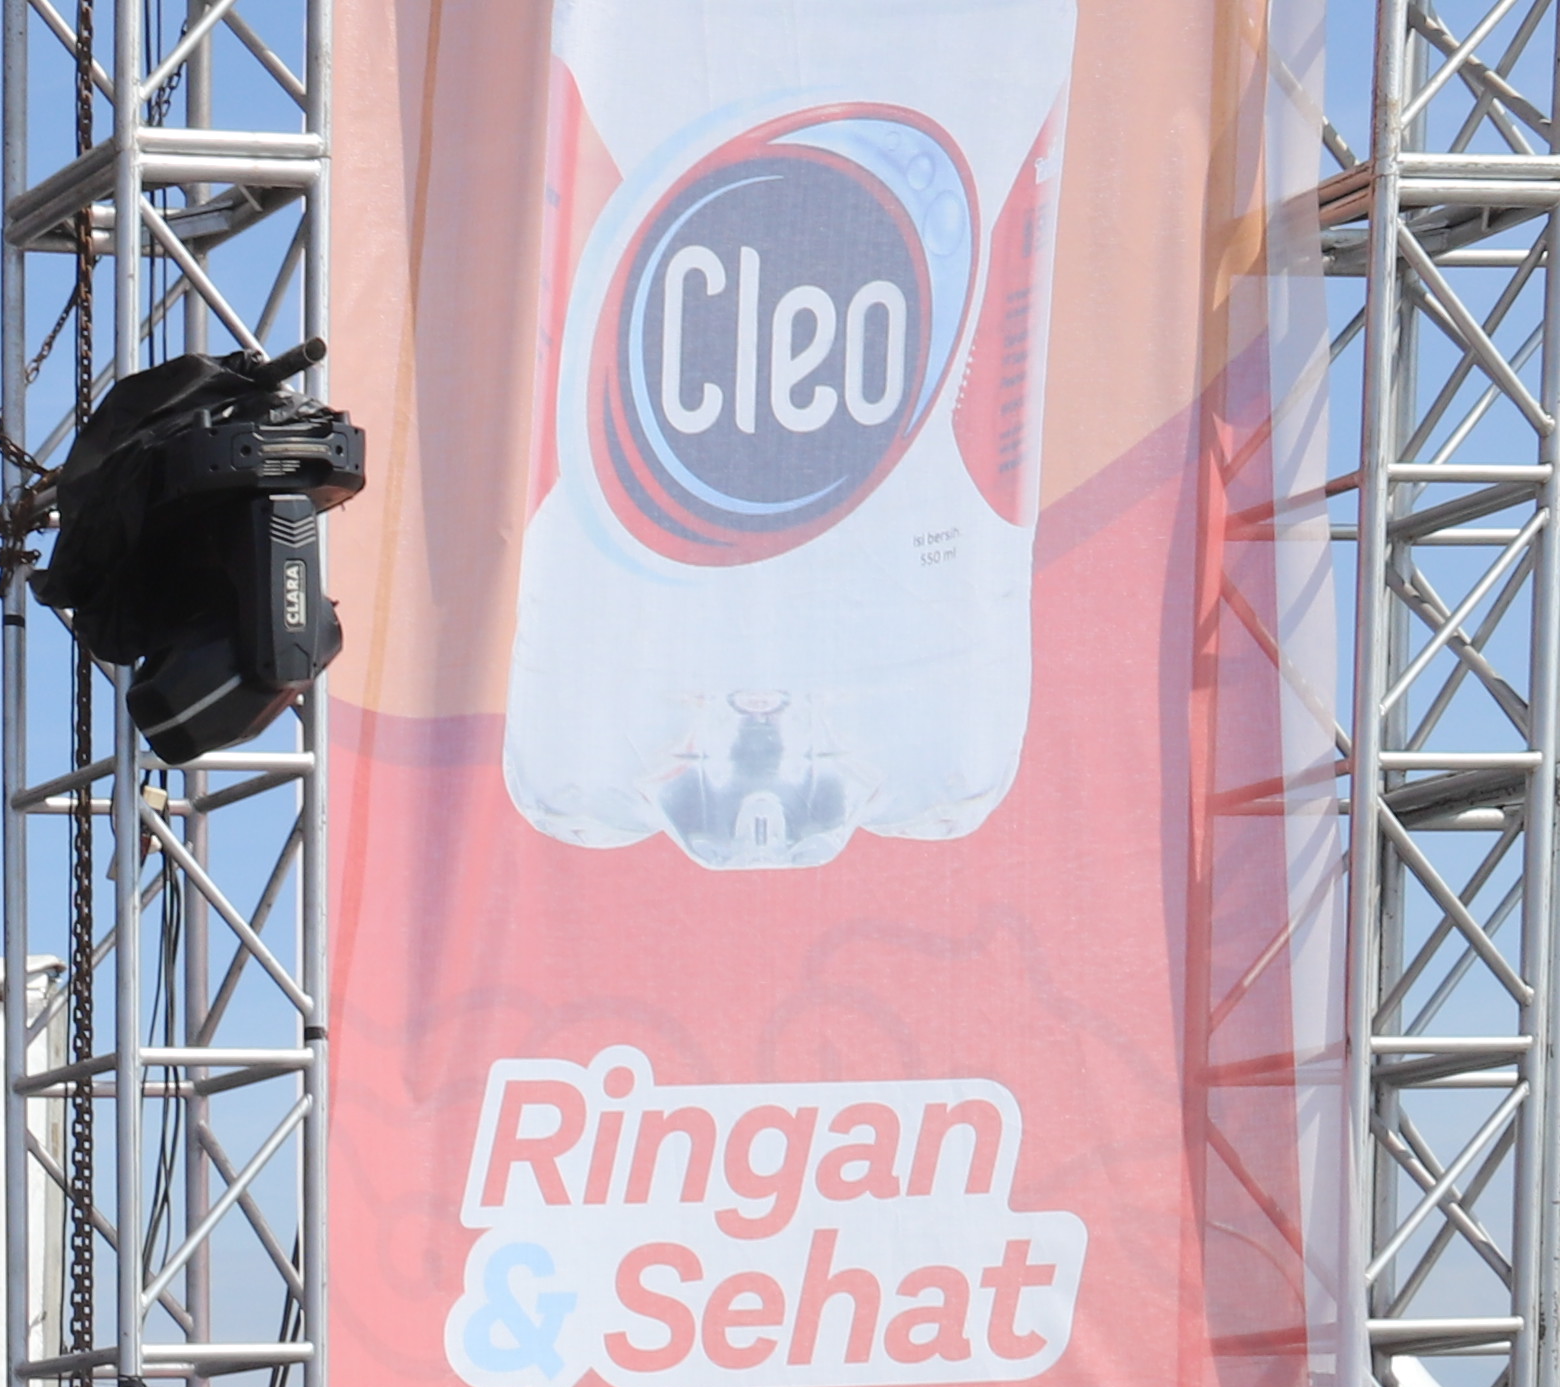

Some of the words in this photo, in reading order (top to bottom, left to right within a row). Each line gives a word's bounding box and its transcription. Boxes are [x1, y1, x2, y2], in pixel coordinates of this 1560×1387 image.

[659, 244, 908, 435] Cleo
[286, 564, 301, 625] CLARA
[928, 527, 961, 546] bersih
[479, 1065, 1004, 1241] Ringan
[460, 1240, 580, 1382] &
[602, 1229, 1058, 1374] Sehat
